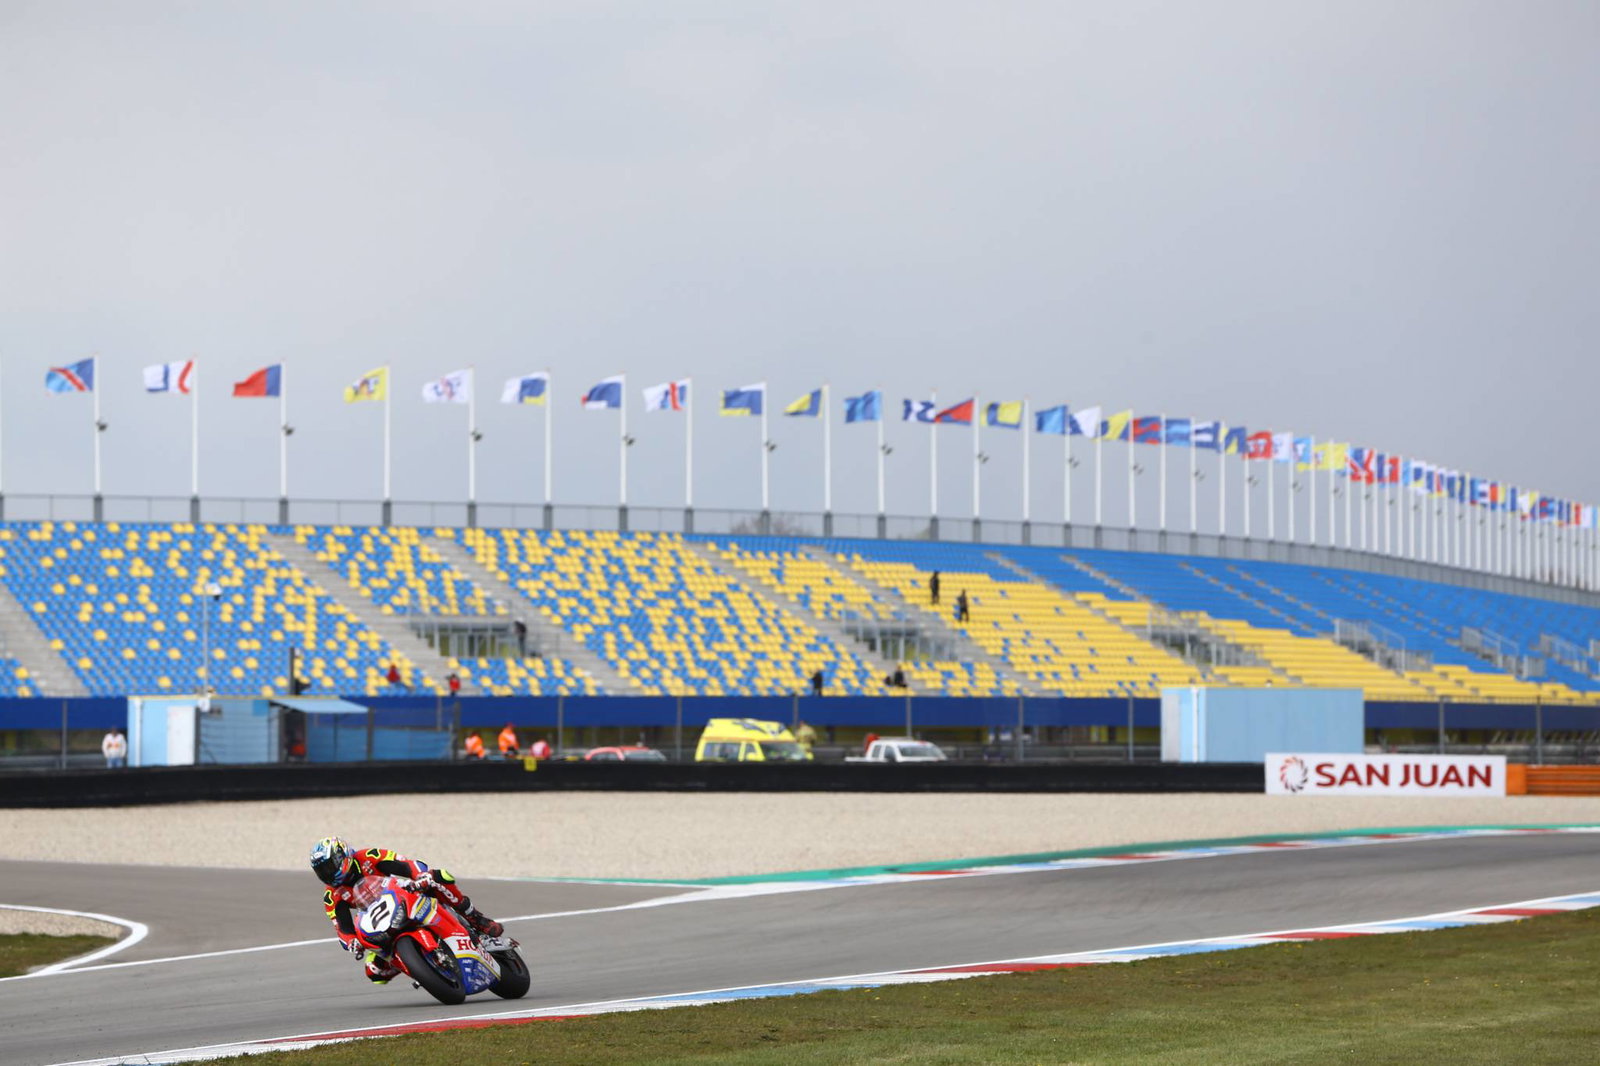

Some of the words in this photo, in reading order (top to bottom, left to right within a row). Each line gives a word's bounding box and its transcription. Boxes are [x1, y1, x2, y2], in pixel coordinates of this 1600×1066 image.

[1315, 763, 1390, 787] SAN
[1400, 764, 1492, 787] JUAN
[370, 900, 390, 930] 2
